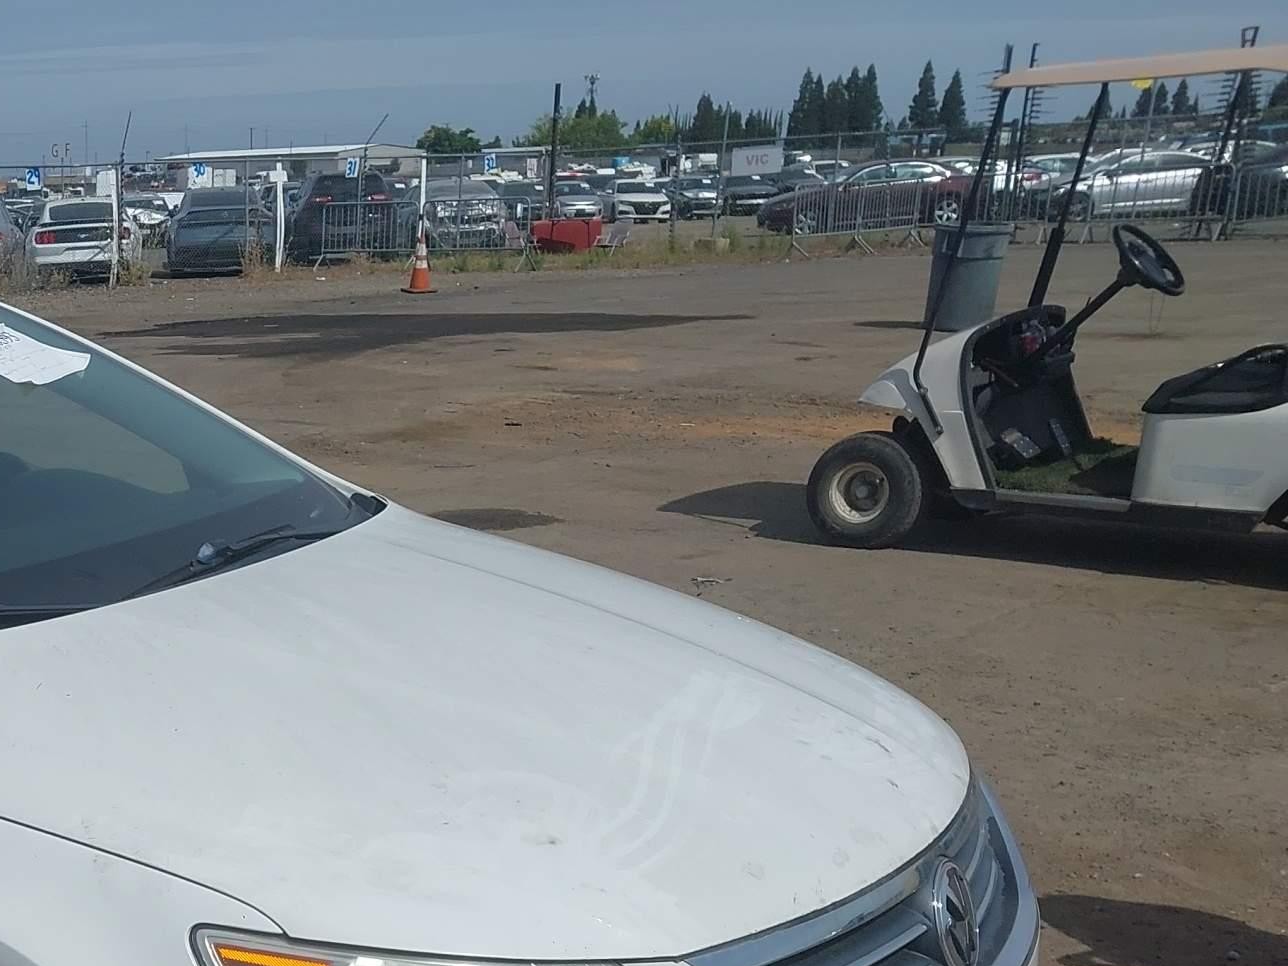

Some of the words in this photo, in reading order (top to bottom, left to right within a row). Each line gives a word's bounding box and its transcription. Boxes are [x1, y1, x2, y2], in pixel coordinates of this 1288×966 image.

[193, 162, 206, 178] 30
[347, 159, 357, 177] 31
[27, 168, 41, 187] 29
